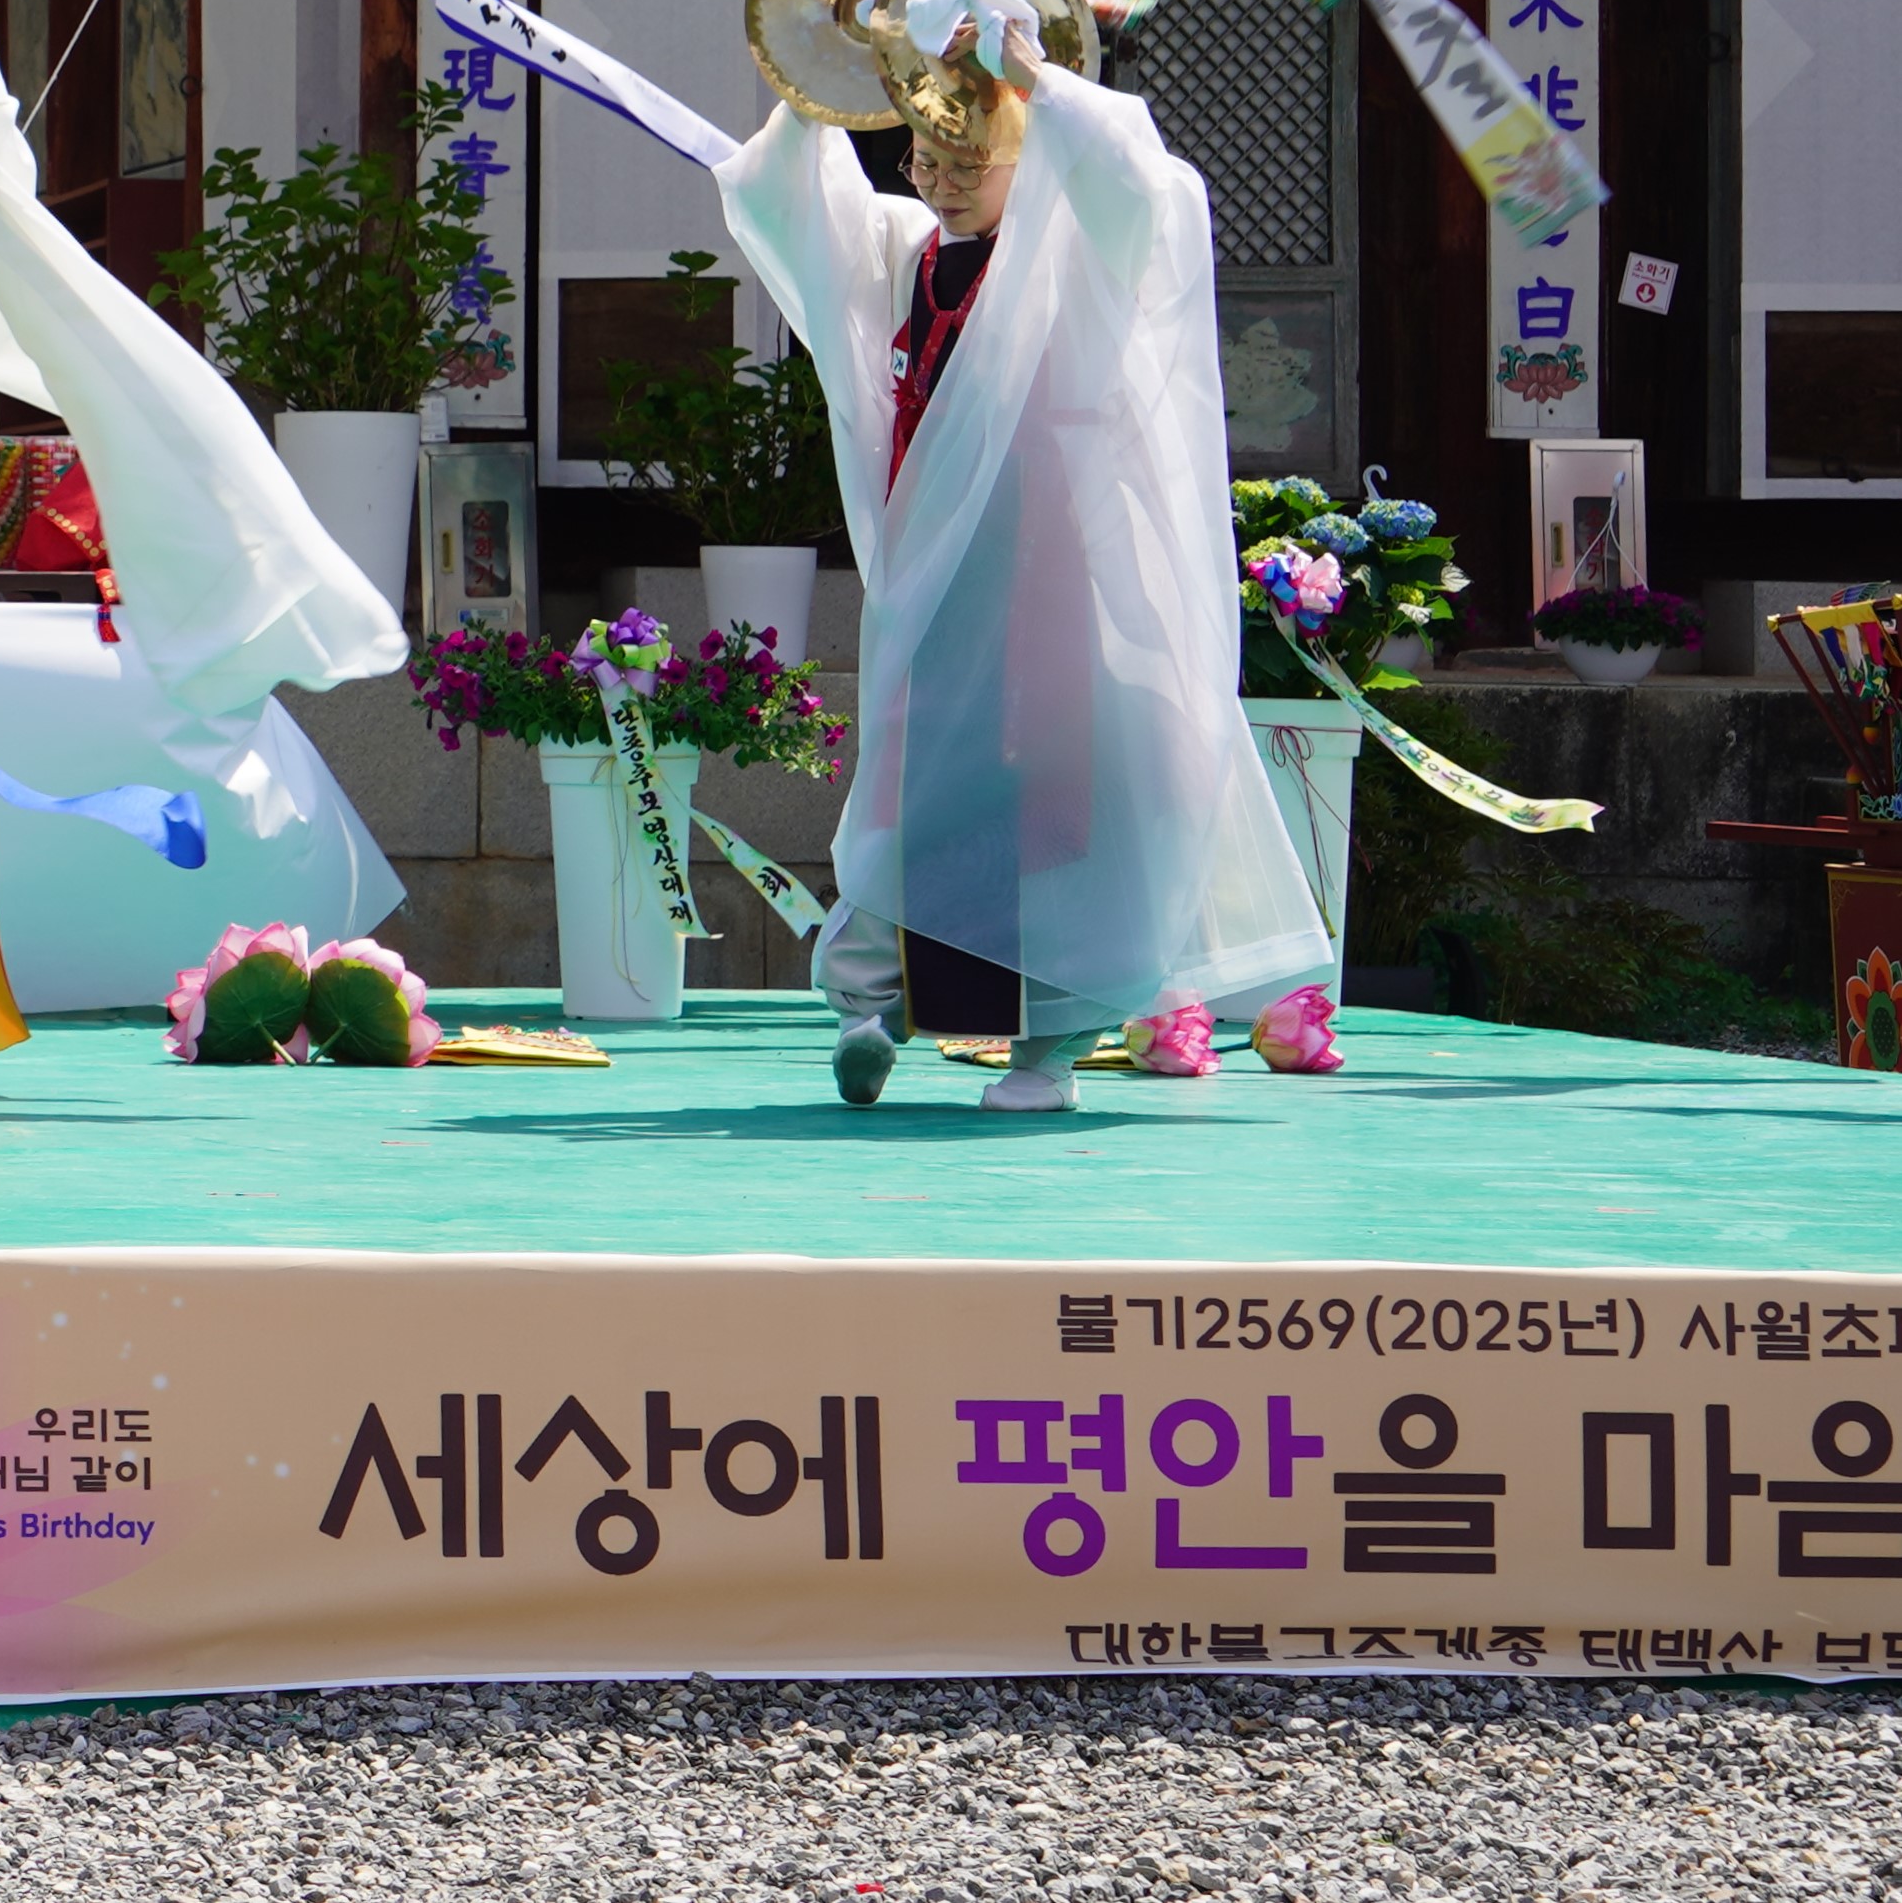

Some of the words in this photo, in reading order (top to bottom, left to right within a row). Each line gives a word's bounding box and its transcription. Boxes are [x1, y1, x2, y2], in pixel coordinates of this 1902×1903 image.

[1633, 259, 1671, 281] 소화기
[1057, 1294, 1645, 1360] 불기2569(2025년)
[1679, 1300, 1902, 1361] 사월초
[27, 1408, 153, 1443] 우리도
[70, 1456, 152, 1493] 같이
[319, 1391, 884, 1575] 세상에
[956, 1393, 1507, 1578] 평안을
[1582, 1400, 1902, 1579] 마음
[20, 1511, 155, 1546] Birthday
